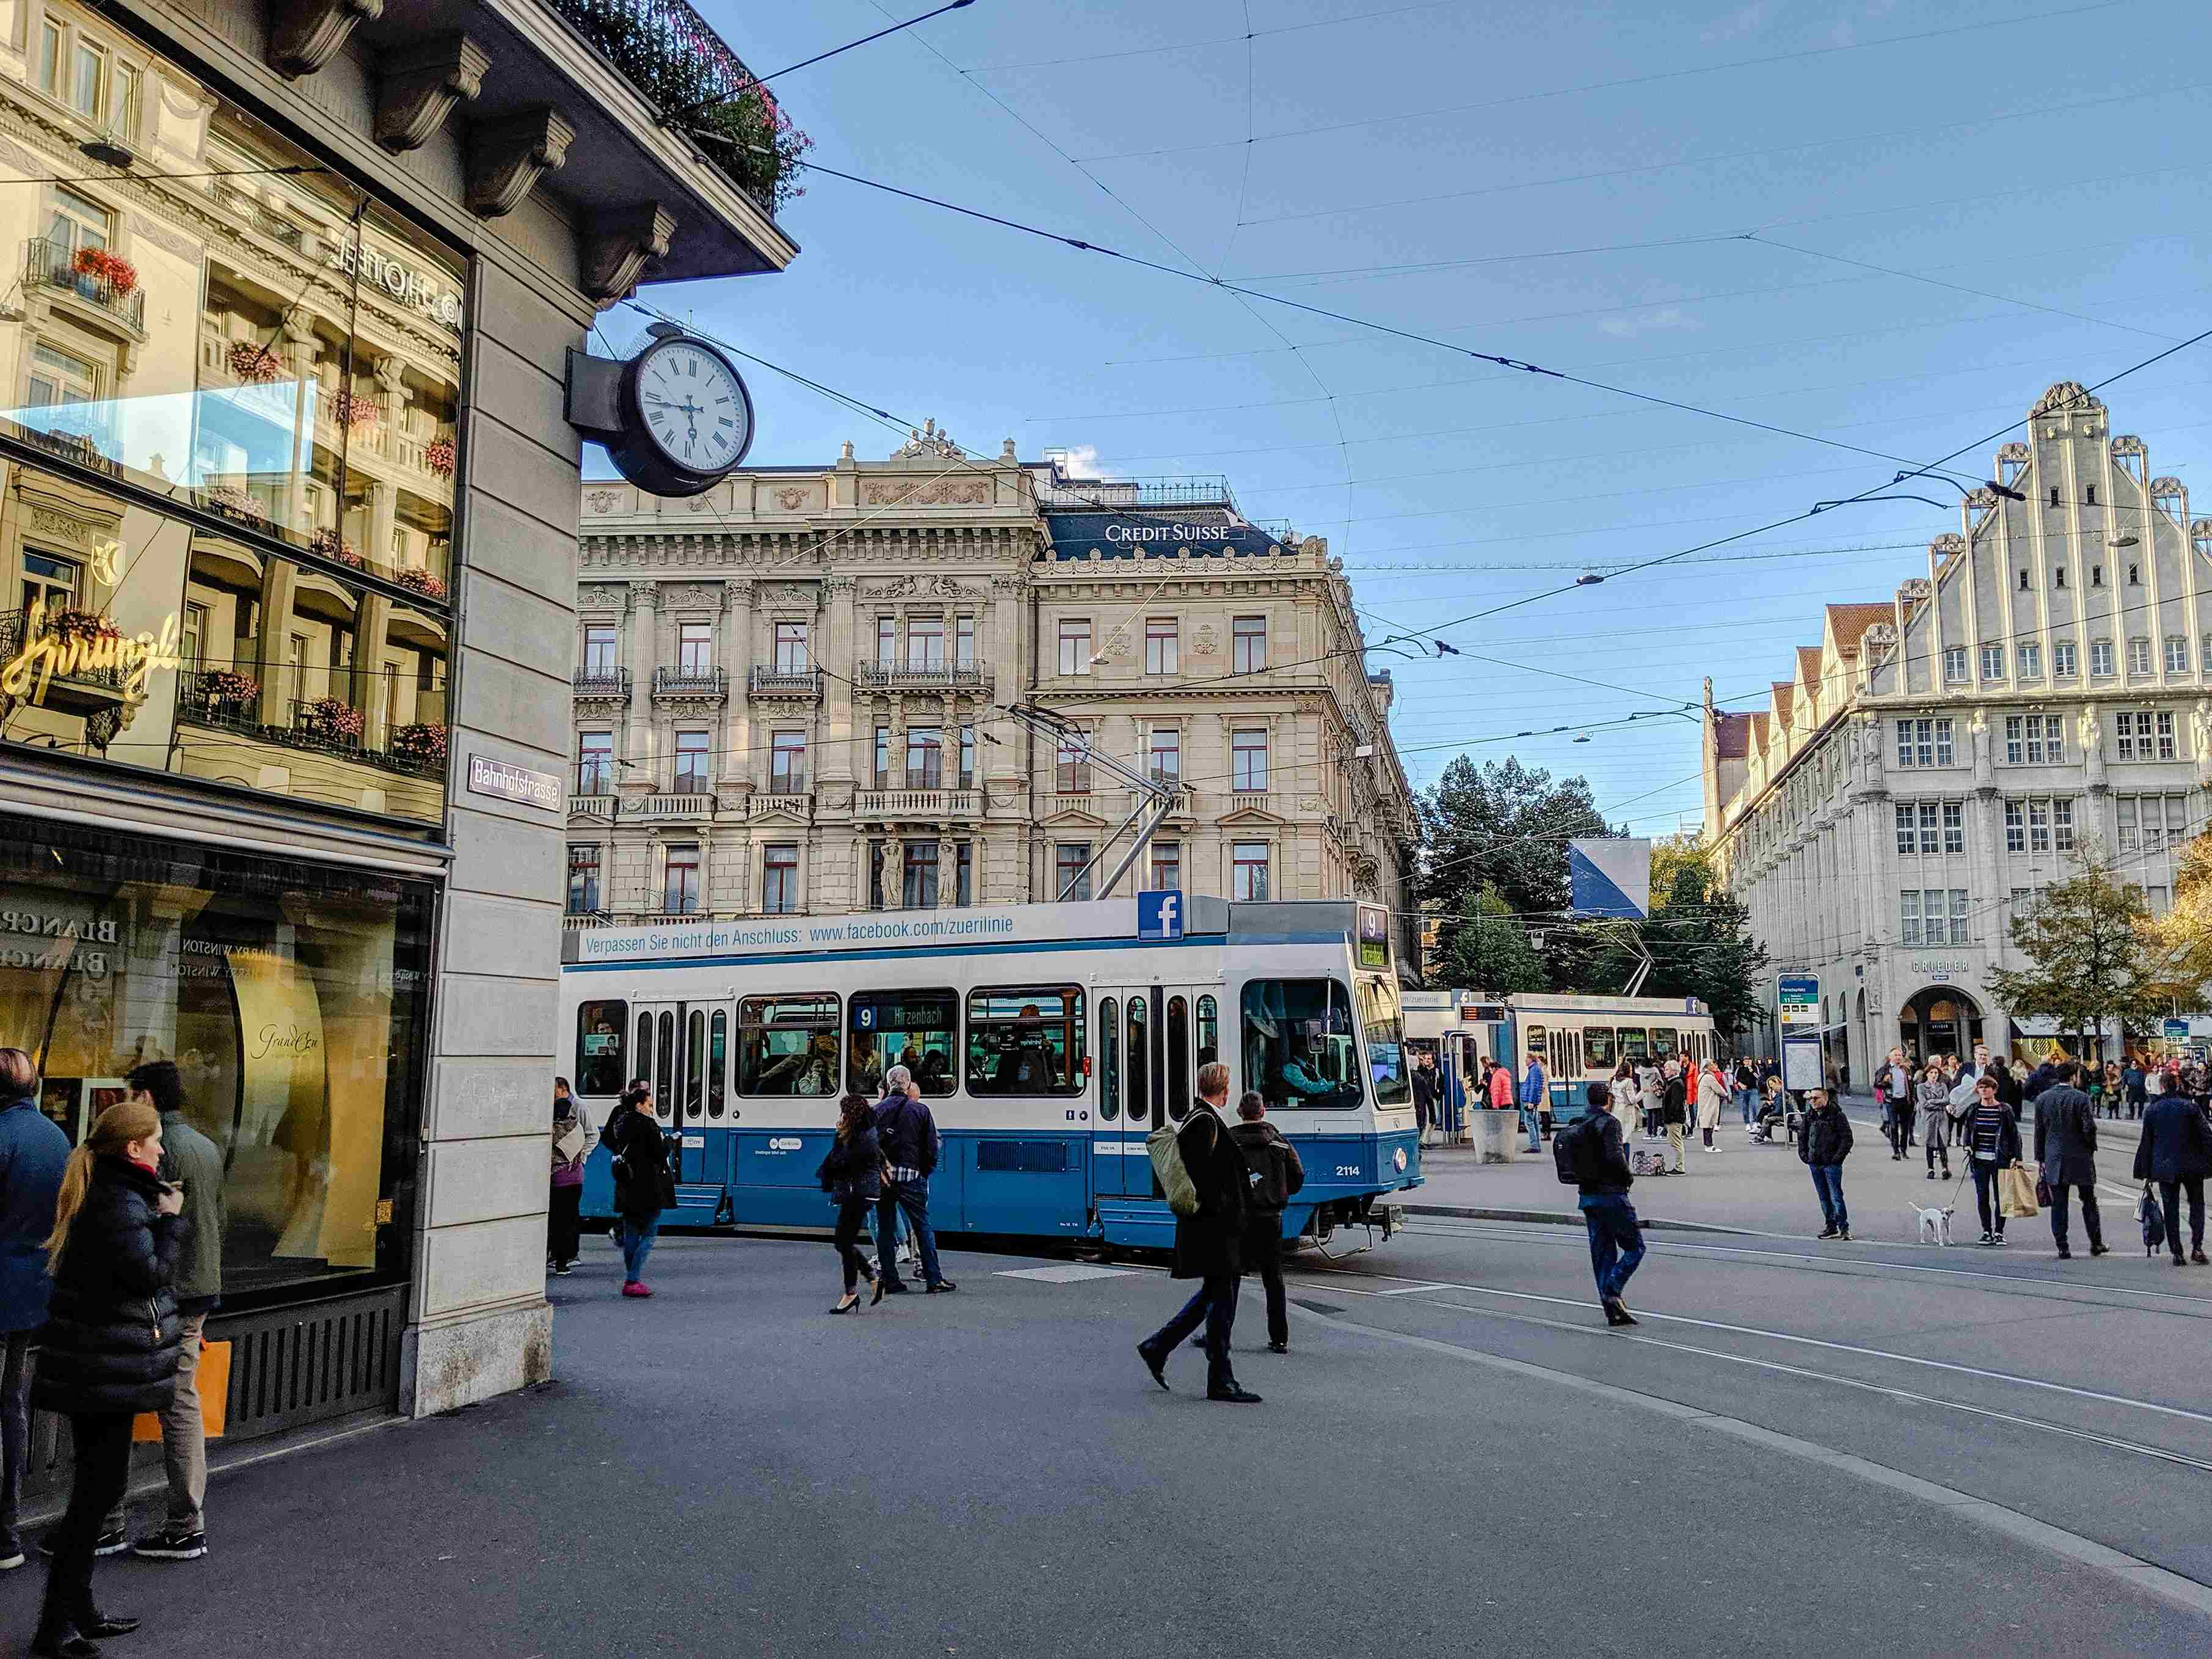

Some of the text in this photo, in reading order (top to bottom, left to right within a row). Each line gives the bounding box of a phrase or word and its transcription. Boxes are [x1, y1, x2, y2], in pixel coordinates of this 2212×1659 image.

[475, 759, 558, 802] Bahnhofstrasse
[586, 914, 1013, 955] Verpassen Sie nicht den Anschluss: www.facebook.com/zuerilinie
[1369, 911, 1376, 938] 9
[1913, 961, 1968, 972] GRIEDER
[860, 1009, 871, 1027] 9
[1336, 1165, 1360, 1176] 2114
